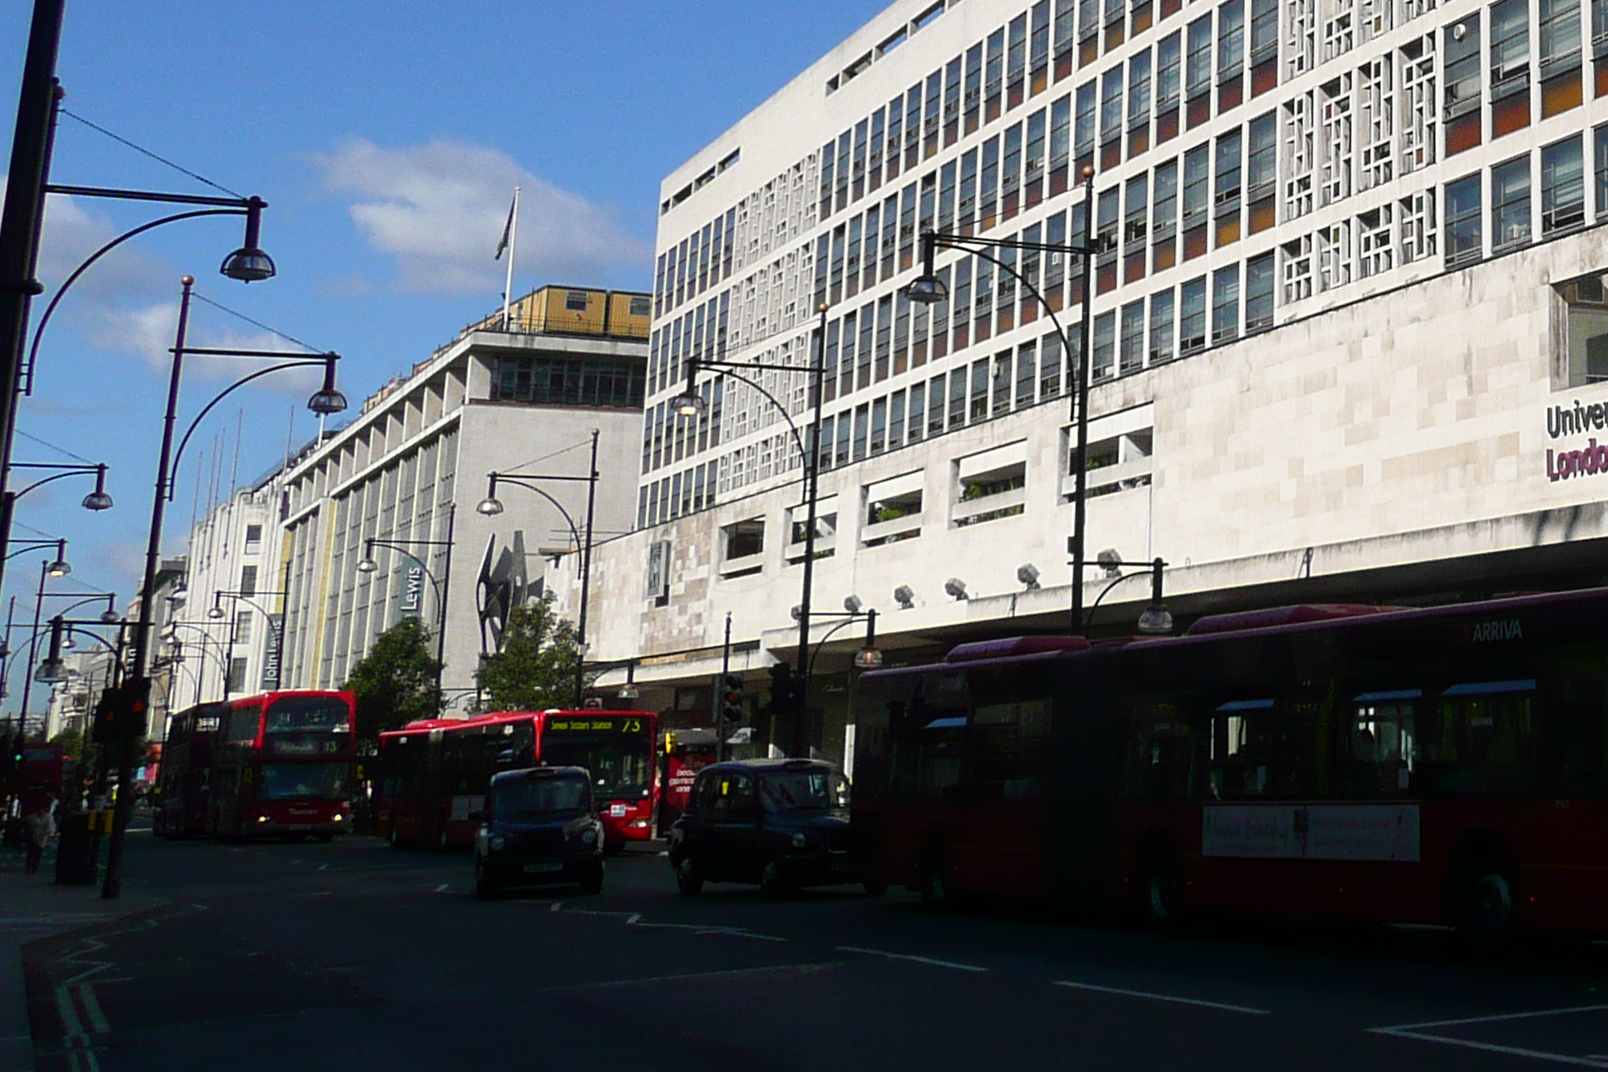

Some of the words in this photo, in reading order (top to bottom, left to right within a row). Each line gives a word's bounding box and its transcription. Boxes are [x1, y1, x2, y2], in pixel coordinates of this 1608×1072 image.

[399, 566, 421, 610] Lewis
[1472, 618, 1523, 642] ARRIVA
[621, 718, 641, 733] 73
